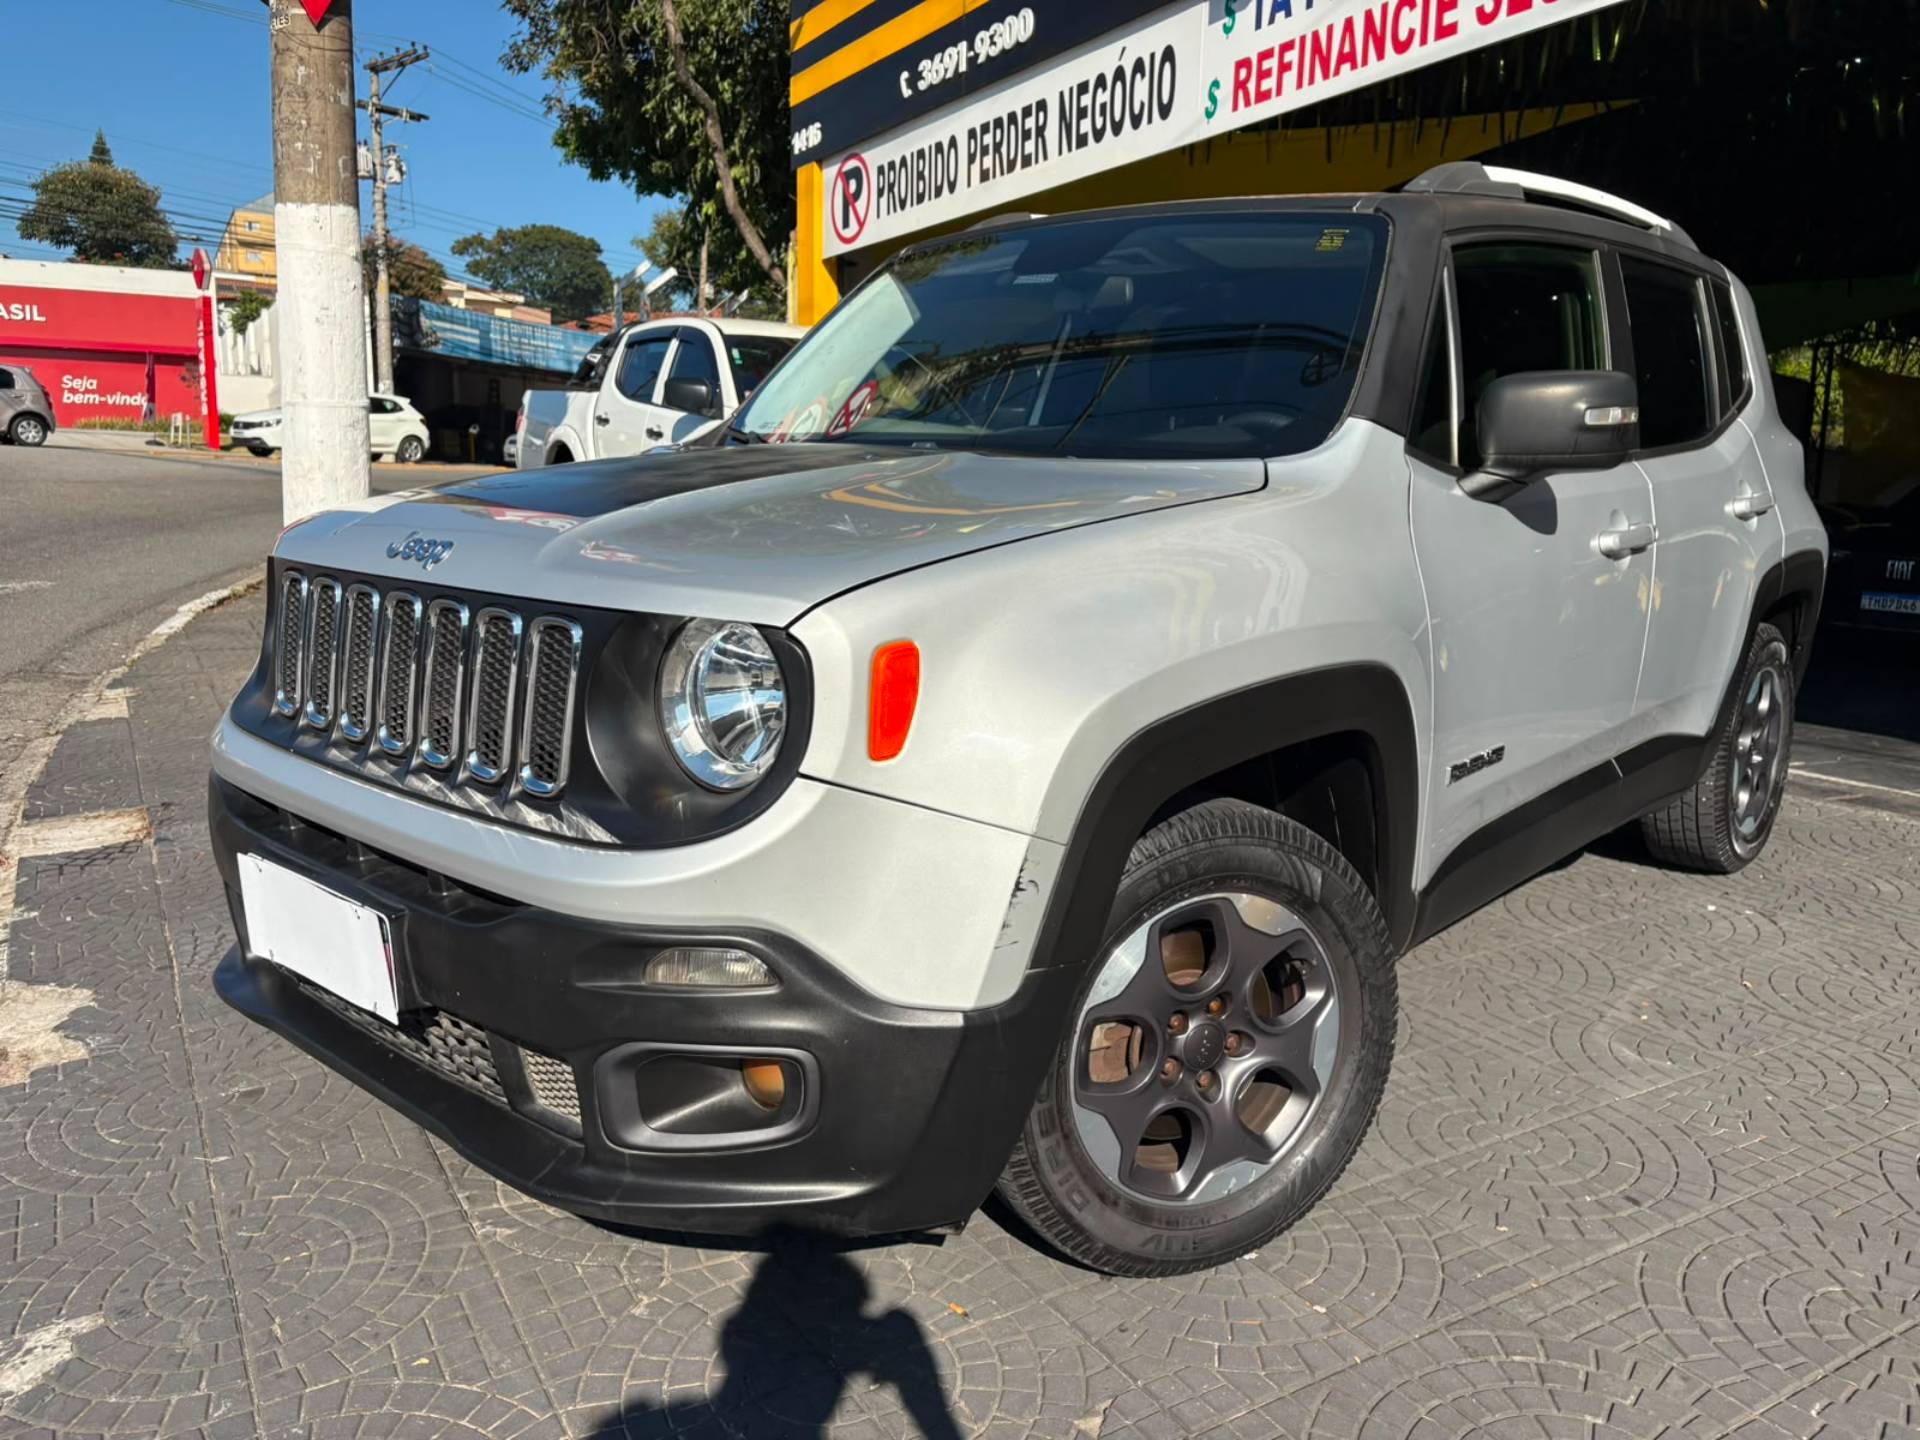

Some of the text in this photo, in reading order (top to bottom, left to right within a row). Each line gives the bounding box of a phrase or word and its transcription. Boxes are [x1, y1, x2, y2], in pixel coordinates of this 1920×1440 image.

[917, 7, 1034, 91] 3691-9300
[1232, 0, 1459, 113] REFINANCIE
[876, 133, 959, 219] PROIBIDO
[967, 97, 1048, 189] PERDER
[1058, 44, 1176, 157] NEGÓCIO
[61, 375, 97, 391] Seja
[386, 530, 455, 571] Jeep
[1885, 560, 1916, 580] FIAT
